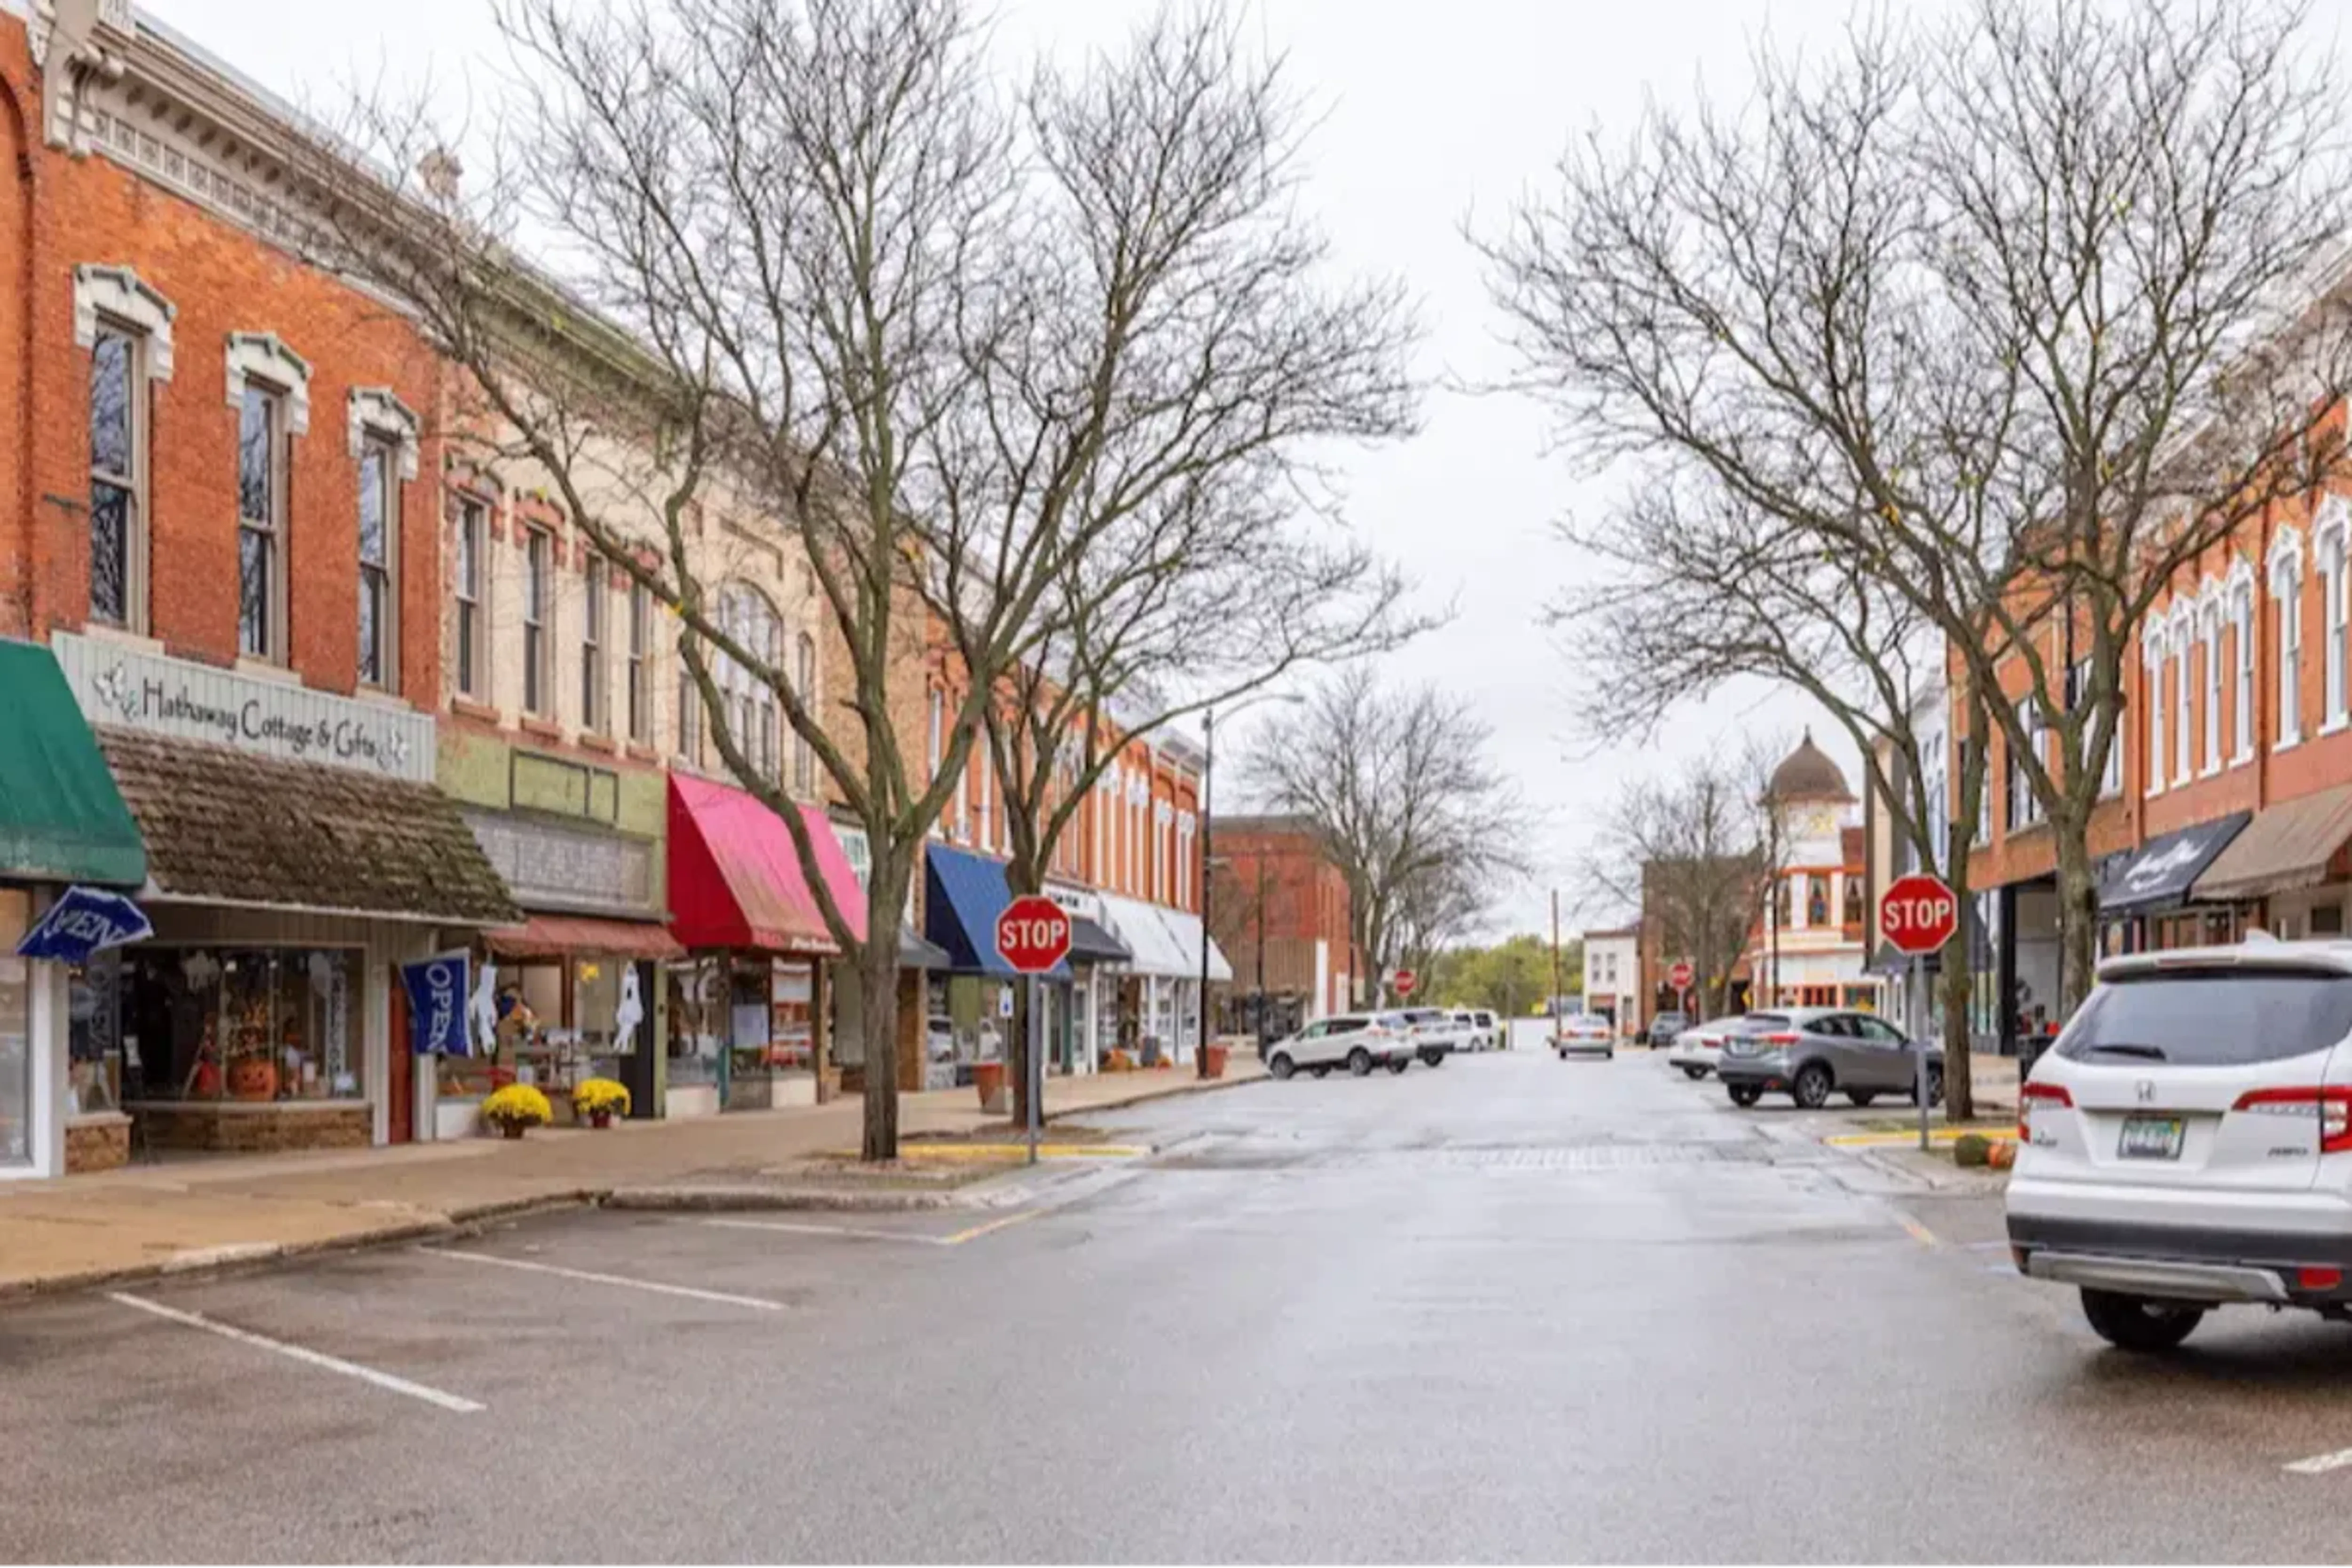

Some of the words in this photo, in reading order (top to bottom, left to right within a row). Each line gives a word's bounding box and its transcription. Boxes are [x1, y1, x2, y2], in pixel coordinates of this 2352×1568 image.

[317, 718, 331, 748] &
[1885, 898, 1950, 931] STOP
[1001, 918, 1066, 949] STOP
